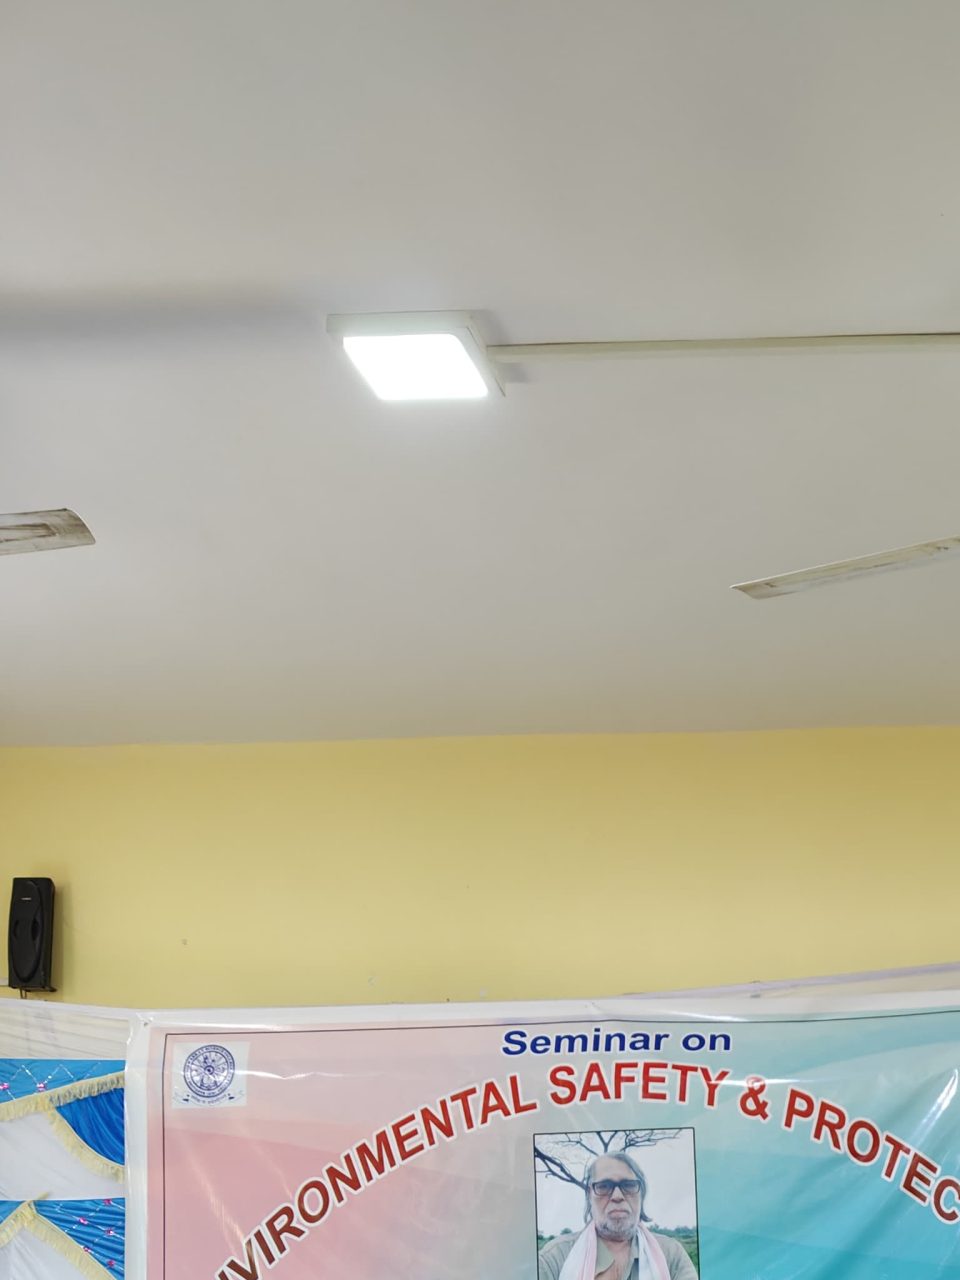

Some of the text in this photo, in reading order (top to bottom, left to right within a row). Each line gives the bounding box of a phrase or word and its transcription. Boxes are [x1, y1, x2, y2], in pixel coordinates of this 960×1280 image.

[502, 1027, 732, 1055] Seminar on
[549, 1061, 730, 1107] SAFETY
[739, 1076, 769, 1121] &
